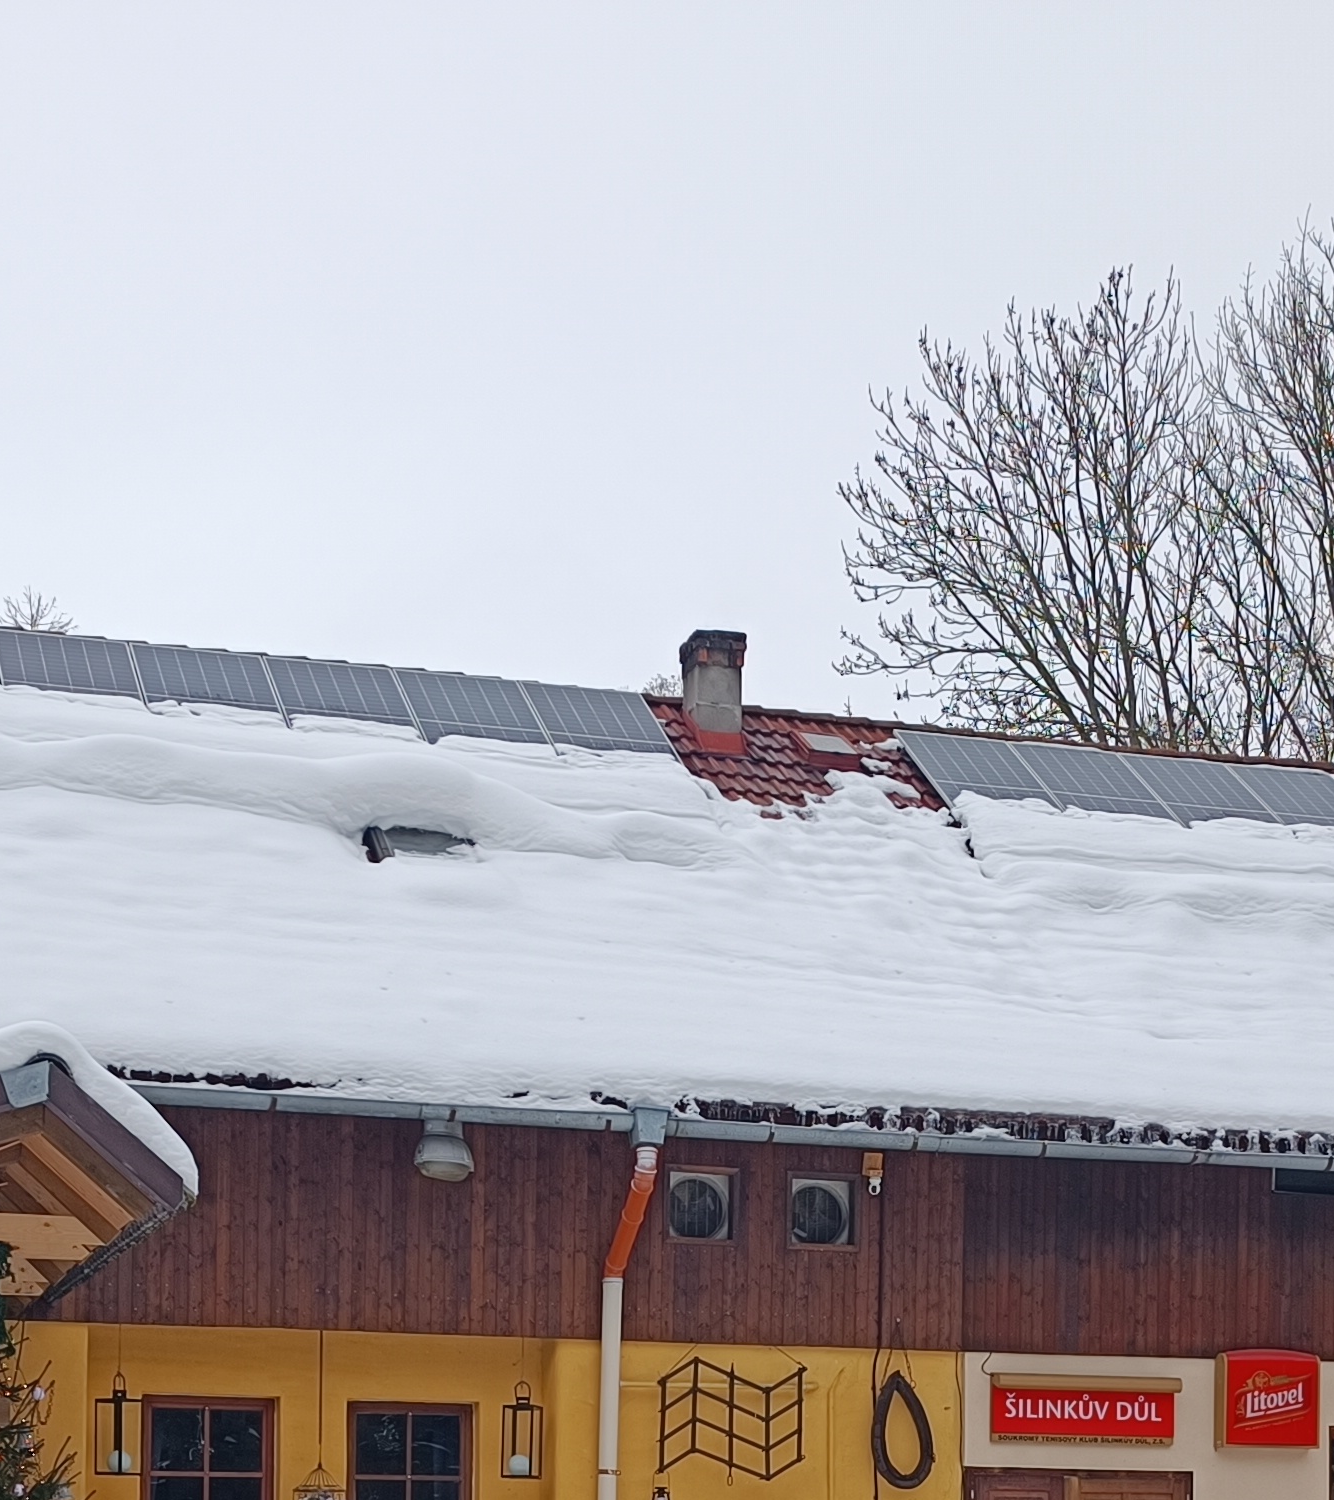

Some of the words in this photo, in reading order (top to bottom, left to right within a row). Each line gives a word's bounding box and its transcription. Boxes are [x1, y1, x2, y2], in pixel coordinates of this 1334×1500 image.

[1005, 1392, 1109, 1420] ŠILINKŮV
[1116, 1395, 1162, 1421] DŮL
[1246, 1382, 1303, 1418] Litovel
